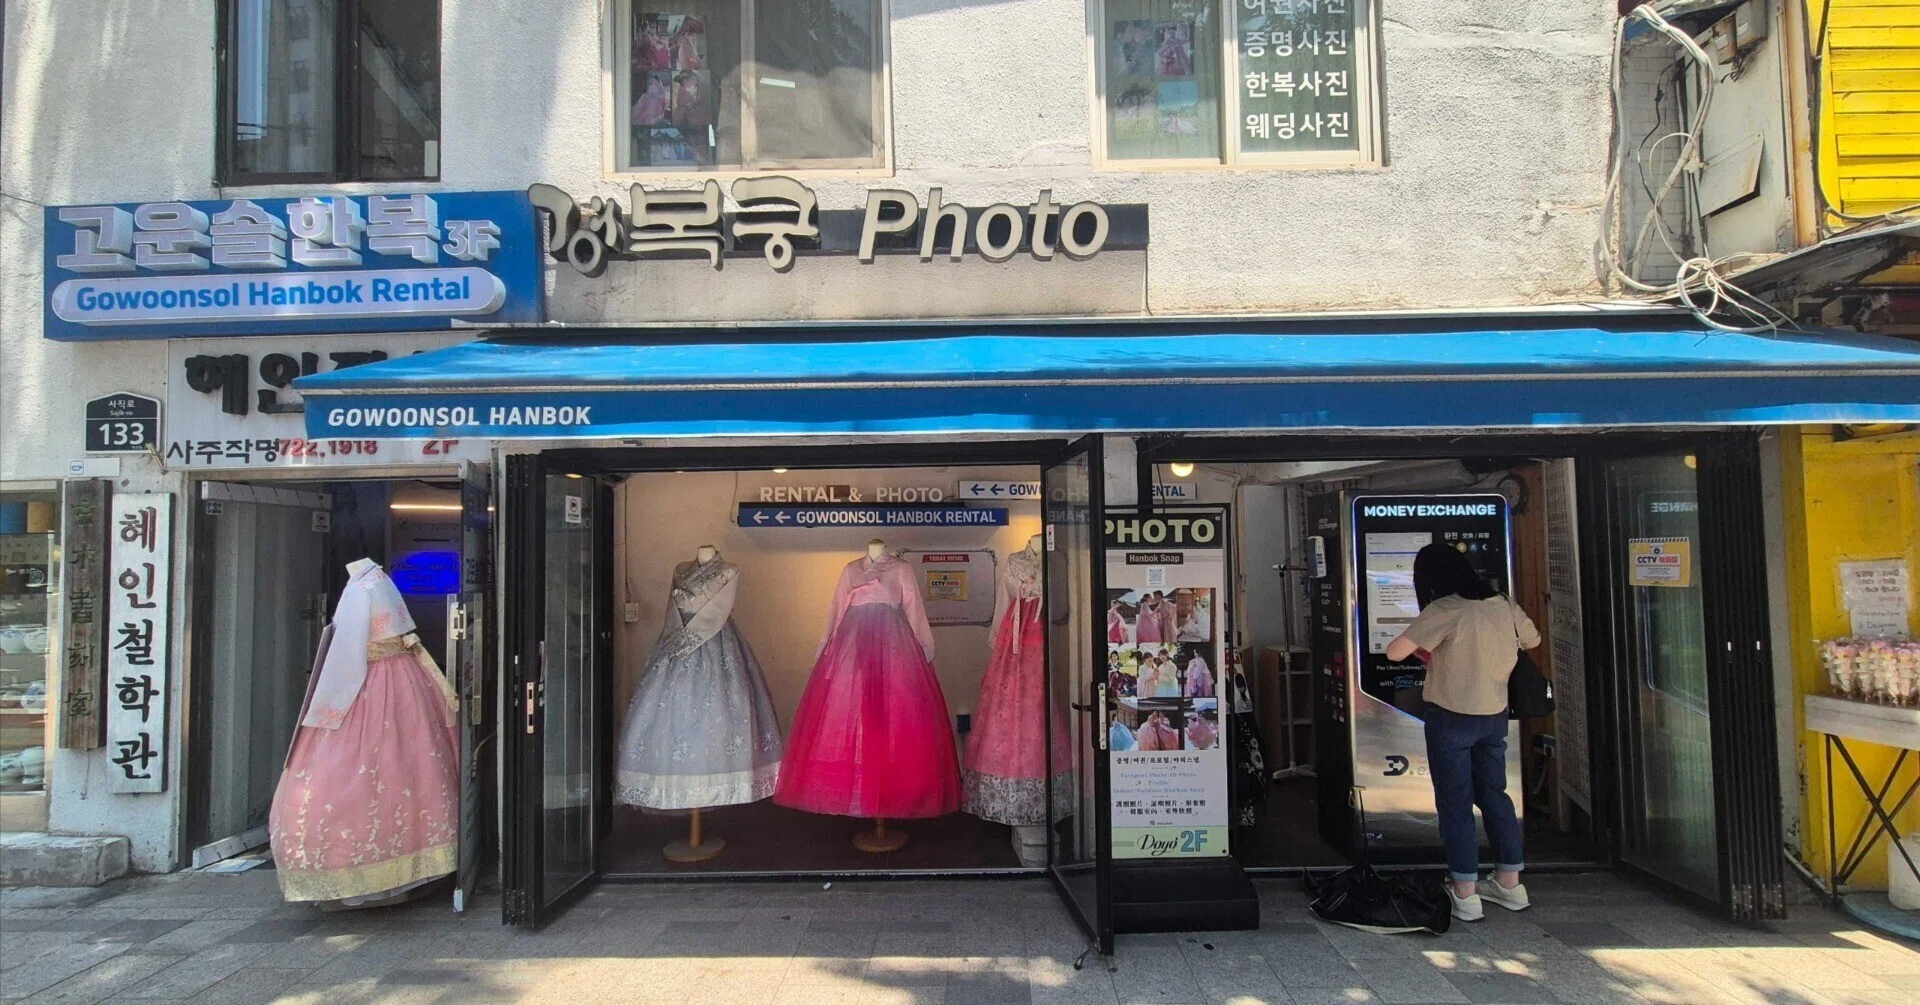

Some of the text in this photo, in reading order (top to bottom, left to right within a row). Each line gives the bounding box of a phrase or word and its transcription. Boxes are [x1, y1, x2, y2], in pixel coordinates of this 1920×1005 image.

[1244, 30, 1347, 57] 증명사진
[1245, 70, 1348, 97] 한복사진
[1246, 112, 1349, 139] 웨딩사진
[57, 195, 500, 272] 고운솔한복 3F
[528, 175, 1110, 276] 경복궁 Photo
[77, 276, 470, 310] Gowoonsol Hanbok Rental
[185, 350, 425, 415] 혜인
[108, 399, 135, 409] 사직로
[328, 406, 591, 427] GOWOONSOL HANBOK
[99, 423, 144, 445] 133
[166, 437, 280, 465] 사주작명
[760, 486, 943, 503] RENTAL & PHOTO
[1009, 484, 1042, 496] GOW
[796, 509, 996, 524] GOWOONSOL HANBOK RENTAL
[1364, 505, 1497, 517] MONEY EXCHANGE
[1129, 555, 1180, 564] Hanbok Snap
[112, 506, 159, 780] 혜인철학관
[1180, 830, 1208, 852] 2F
